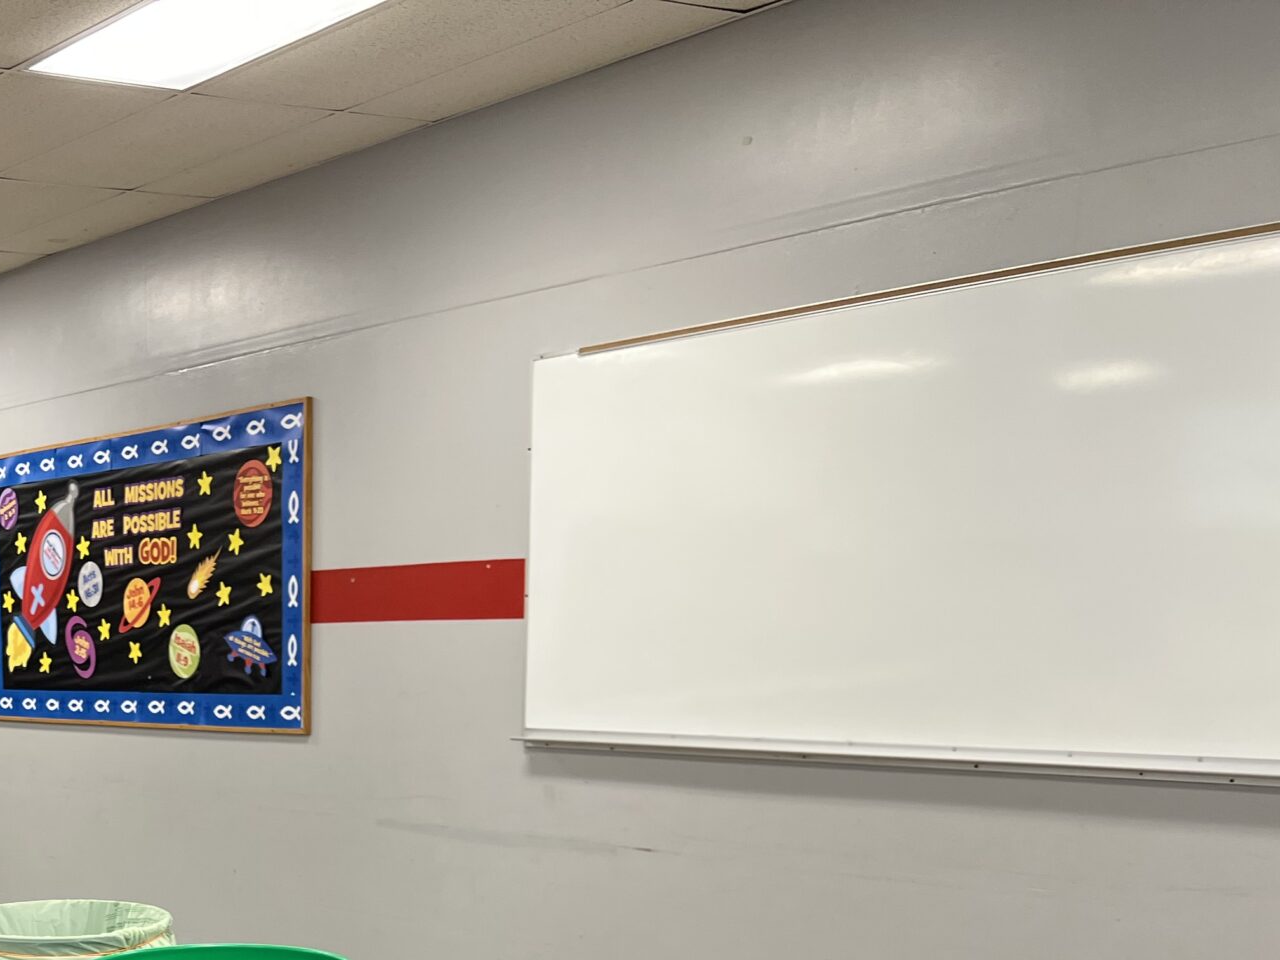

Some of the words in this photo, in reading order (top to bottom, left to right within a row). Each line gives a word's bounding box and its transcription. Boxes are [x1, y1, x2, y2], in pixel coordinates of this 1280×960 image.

[93, 488, 115, 508] ALL
[124, 478, 184, 504] MISSIONS
[91, 518, 114, 539] ARE
[123, 509, 181, 535] POSSIBLE
[104, 546, 133, 567] WITH
[138, 536, 177, 565] GOD!
